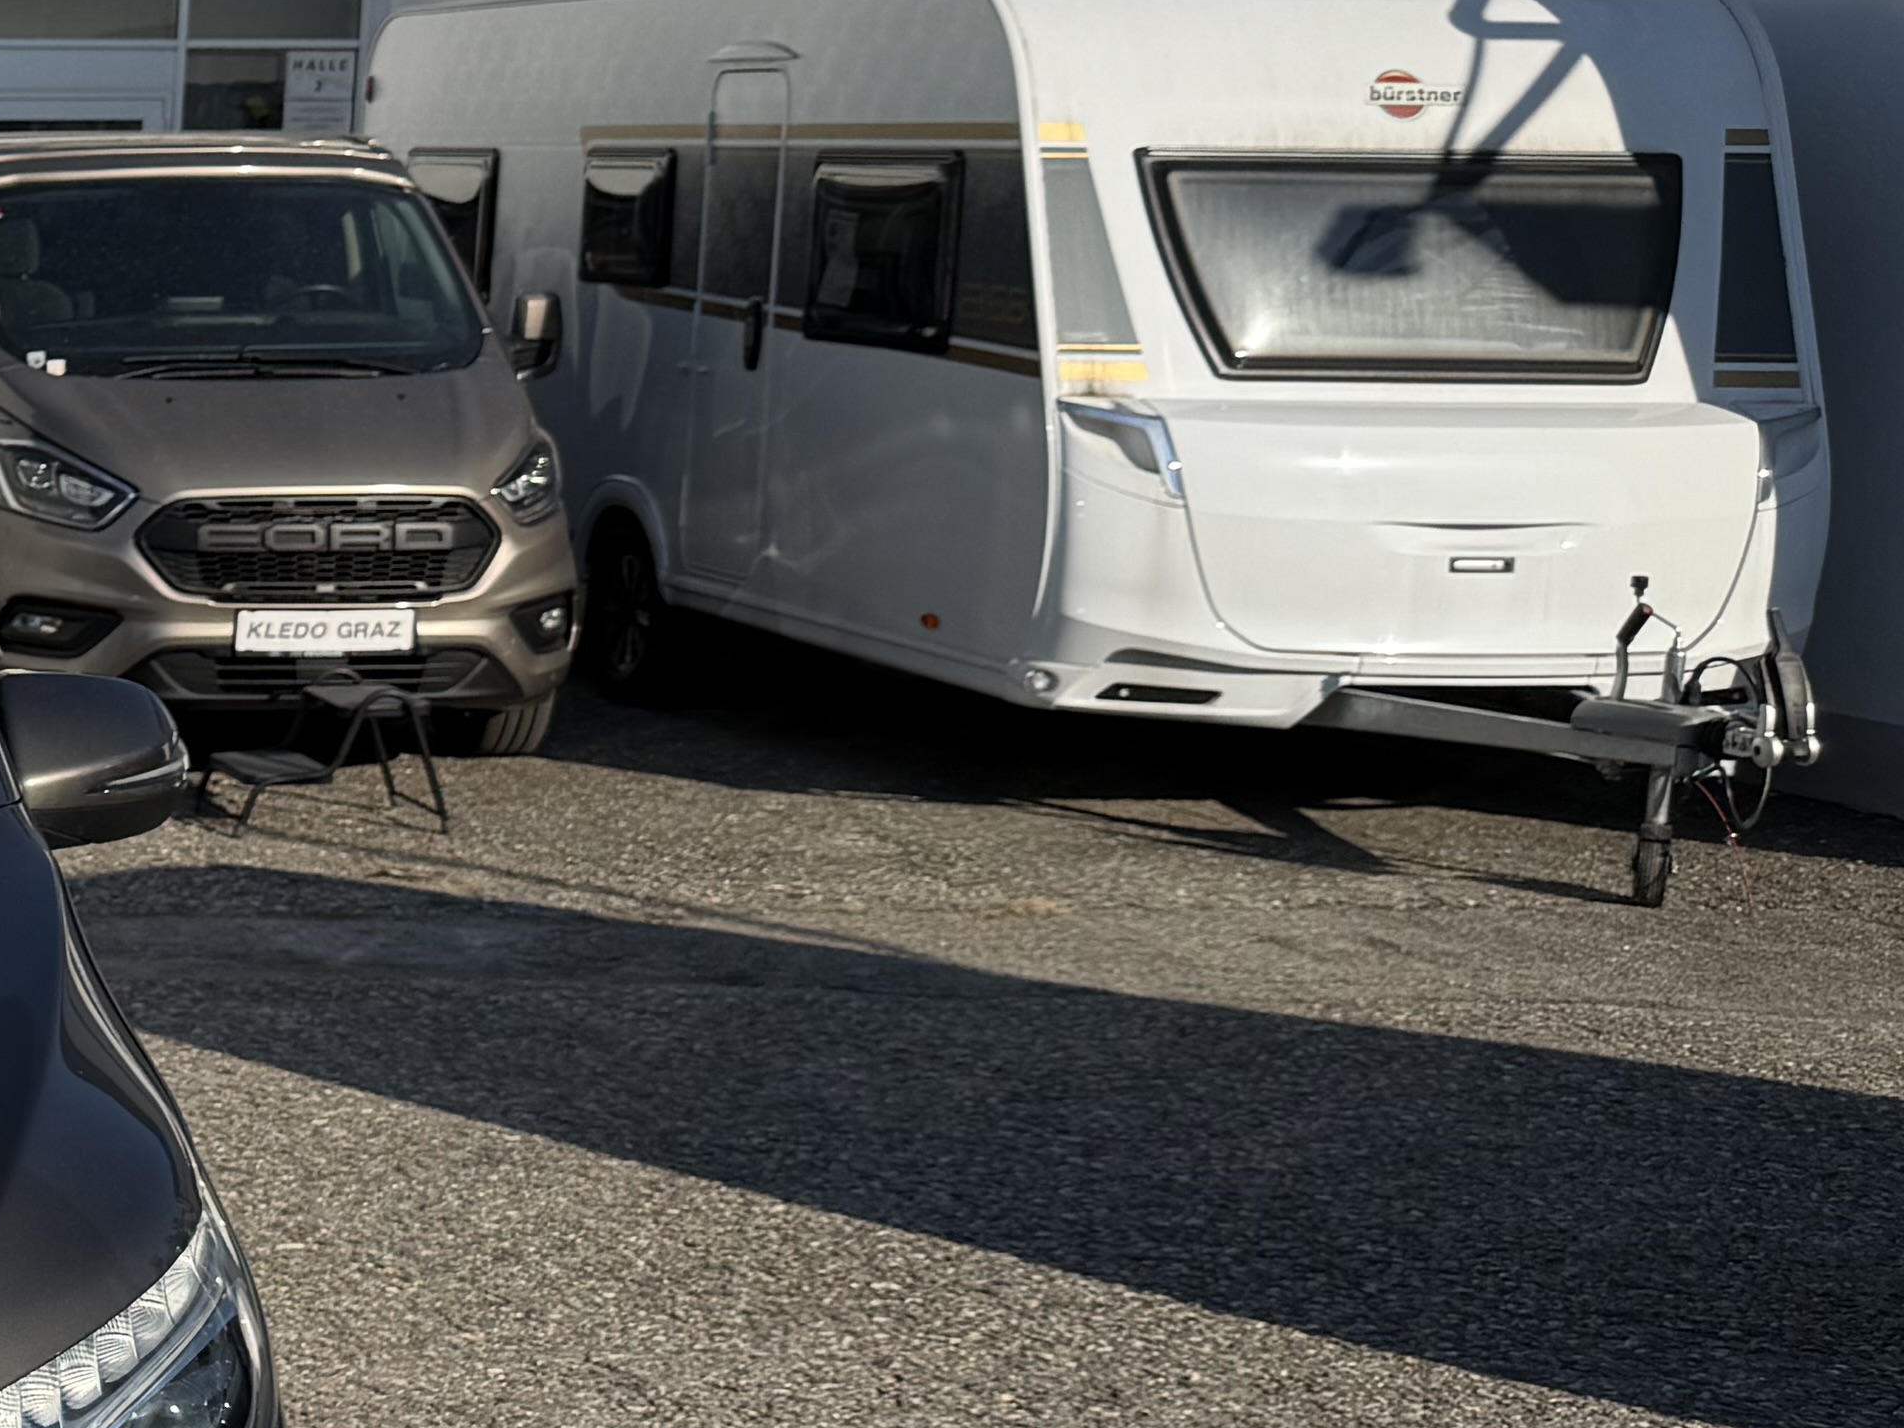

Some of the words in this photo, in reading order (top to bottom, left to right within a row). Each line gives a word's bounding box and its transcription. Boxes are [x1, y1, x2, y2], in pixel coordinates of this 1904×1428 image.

[1369, 85, 1462, 103] bürstner
[196, 522, 454, 552] FORD
[246, 620, 328, 640] KLEDO
[337, 620, 401, 640] GRAZ
